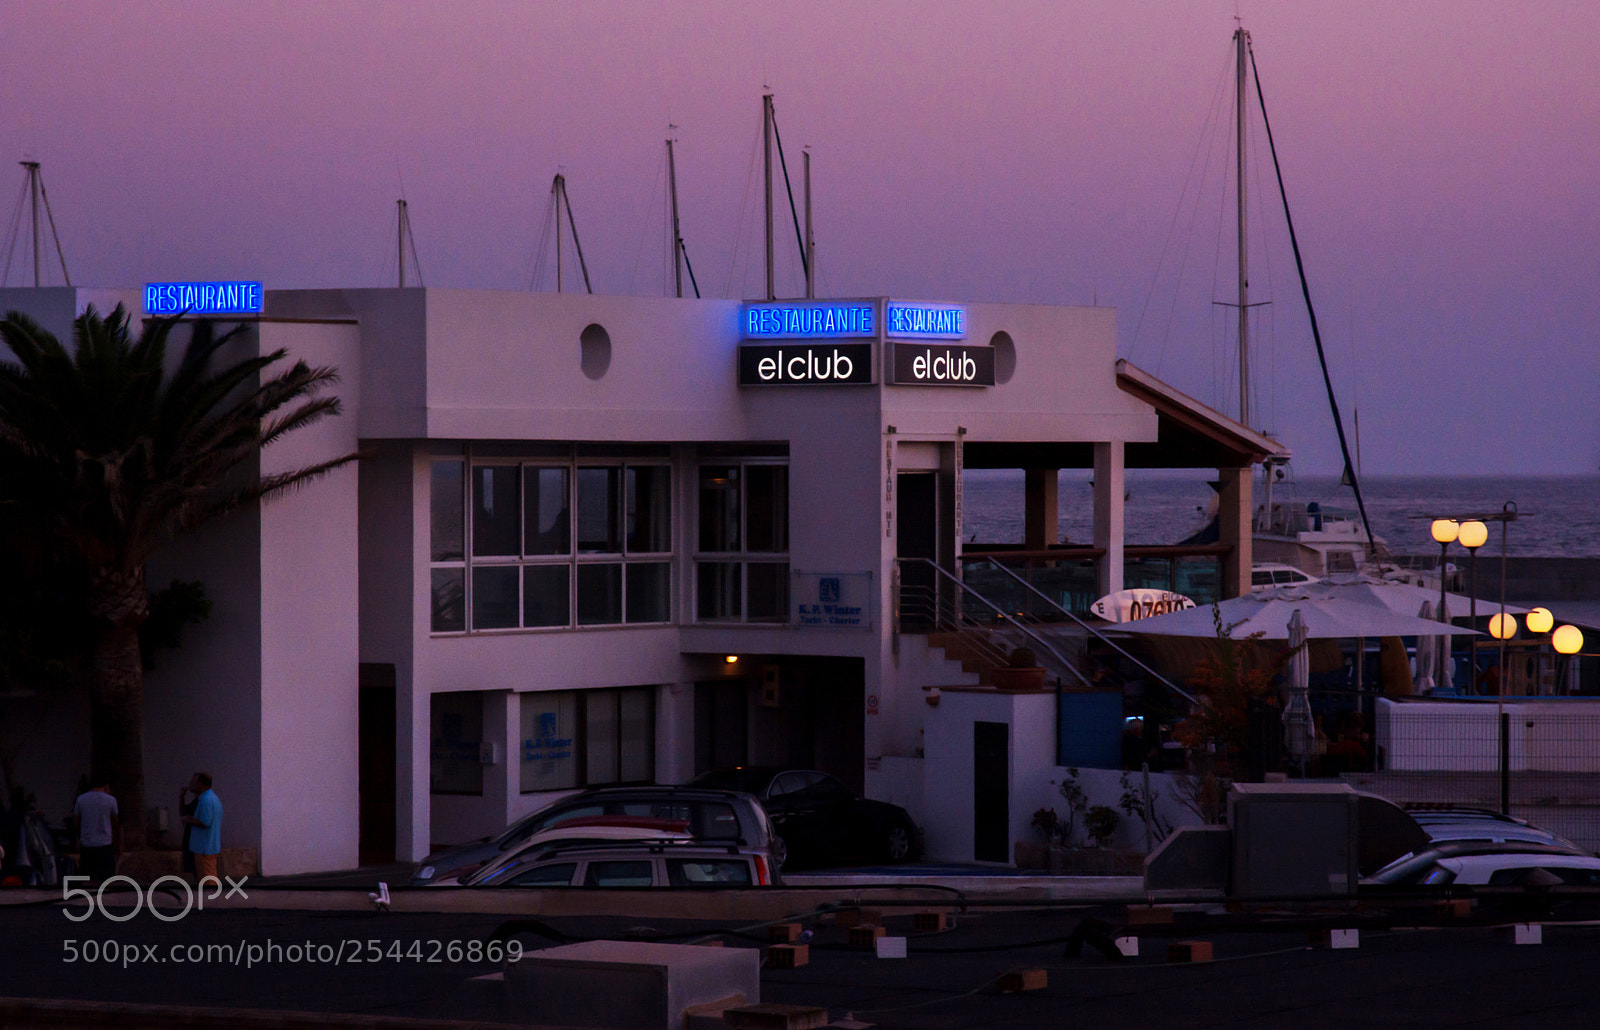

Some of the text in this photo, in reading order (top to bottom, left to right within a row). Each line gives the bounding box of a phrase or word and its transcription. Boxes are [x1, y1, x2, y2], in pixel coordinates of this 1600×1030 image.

[146, 284, 258, 311] RESTAURANTE
[748, 307, 873, 333] RESTAURANTE
[889, 308, 964, 333] RESTAURANTE
[757, 349, 853, 380] el club
[912, 348, 977, 381] el club
[823, 605, 861, 615] Winter
[828, 616, 860, 624] Charter
